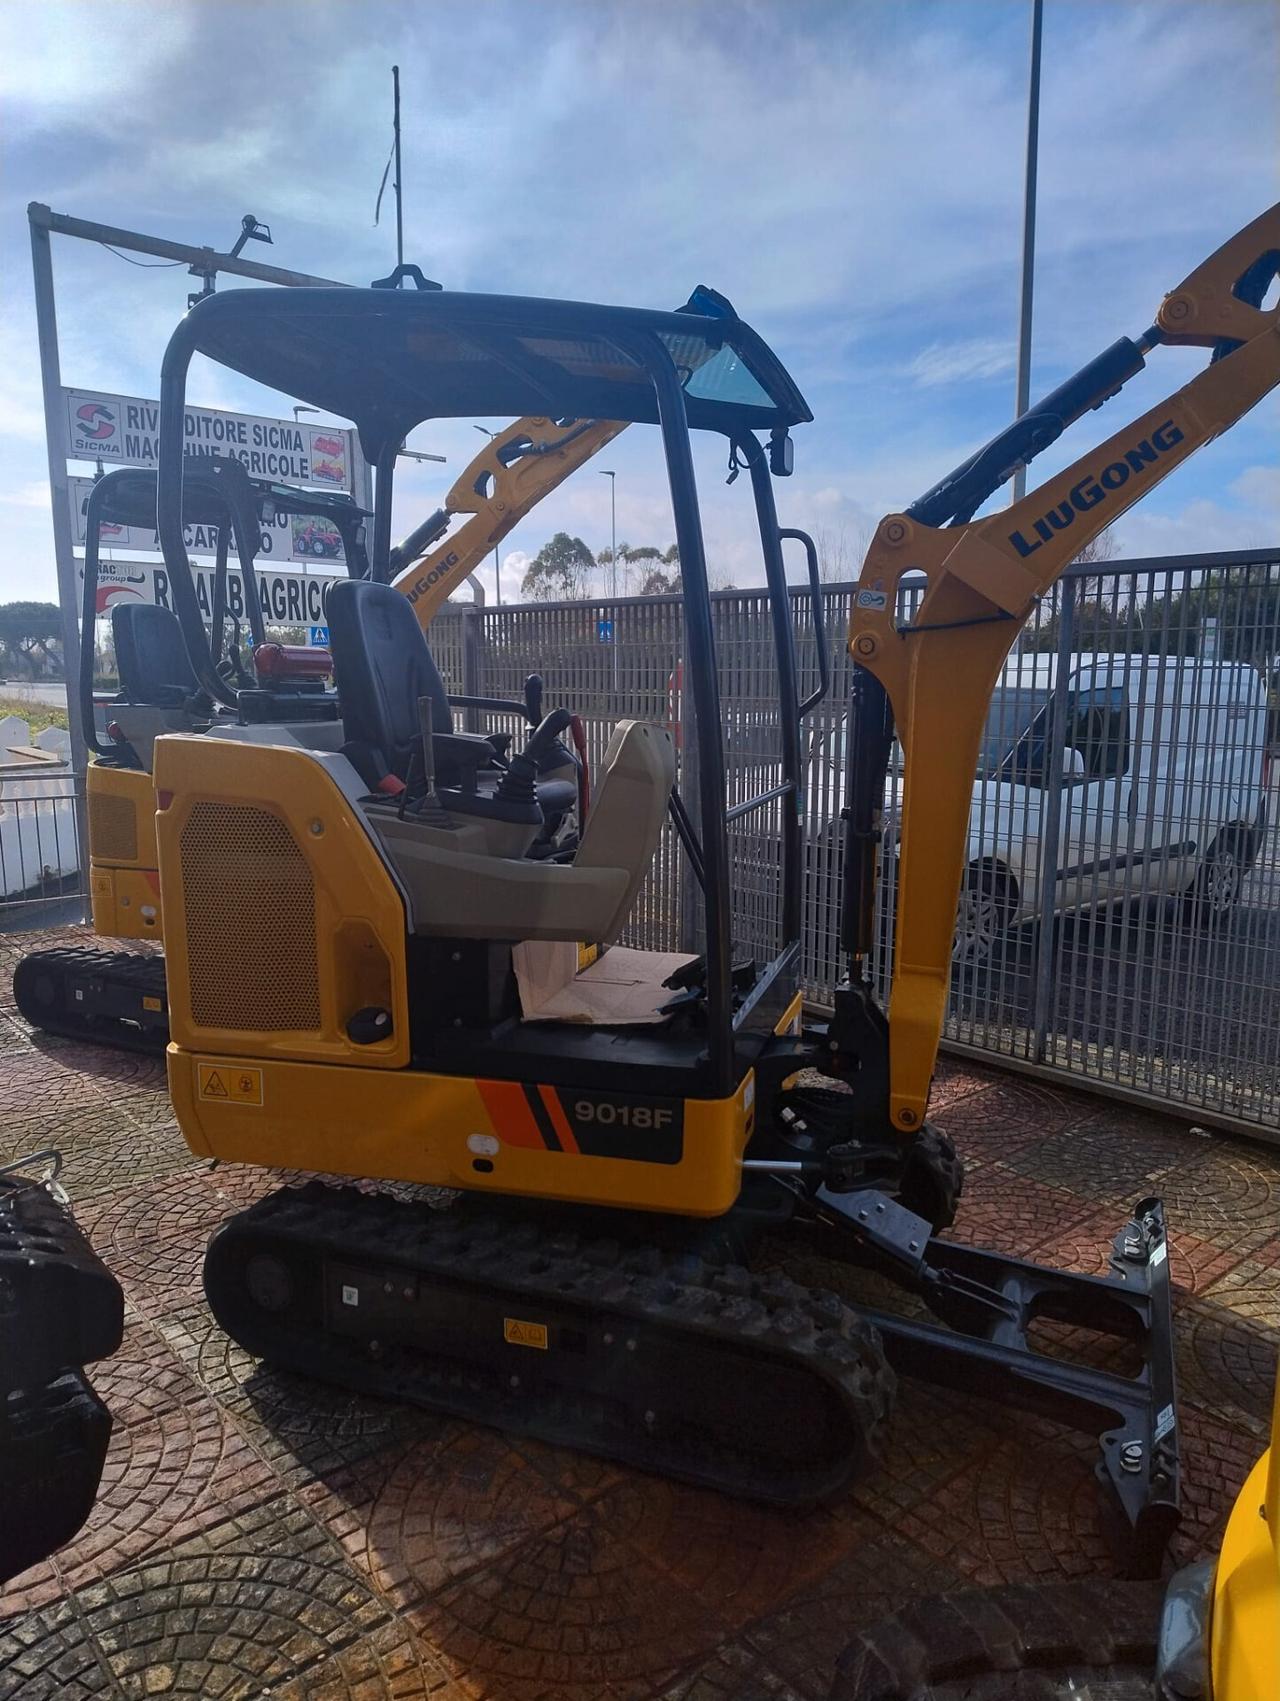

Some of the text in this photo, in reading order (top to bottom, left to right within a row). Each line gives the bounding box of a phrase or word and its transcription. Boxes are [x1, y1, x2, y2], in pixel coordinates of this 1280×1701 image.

[75, 439, 121, 453] SICMA
[127, 405, 304, 452] RIVDITORE SICMA
[1008, 419, 1185, 558] LIUGONG
[406, 551, 459, 604] UGONG
[575, 1101, 672, 1129] 9018F
